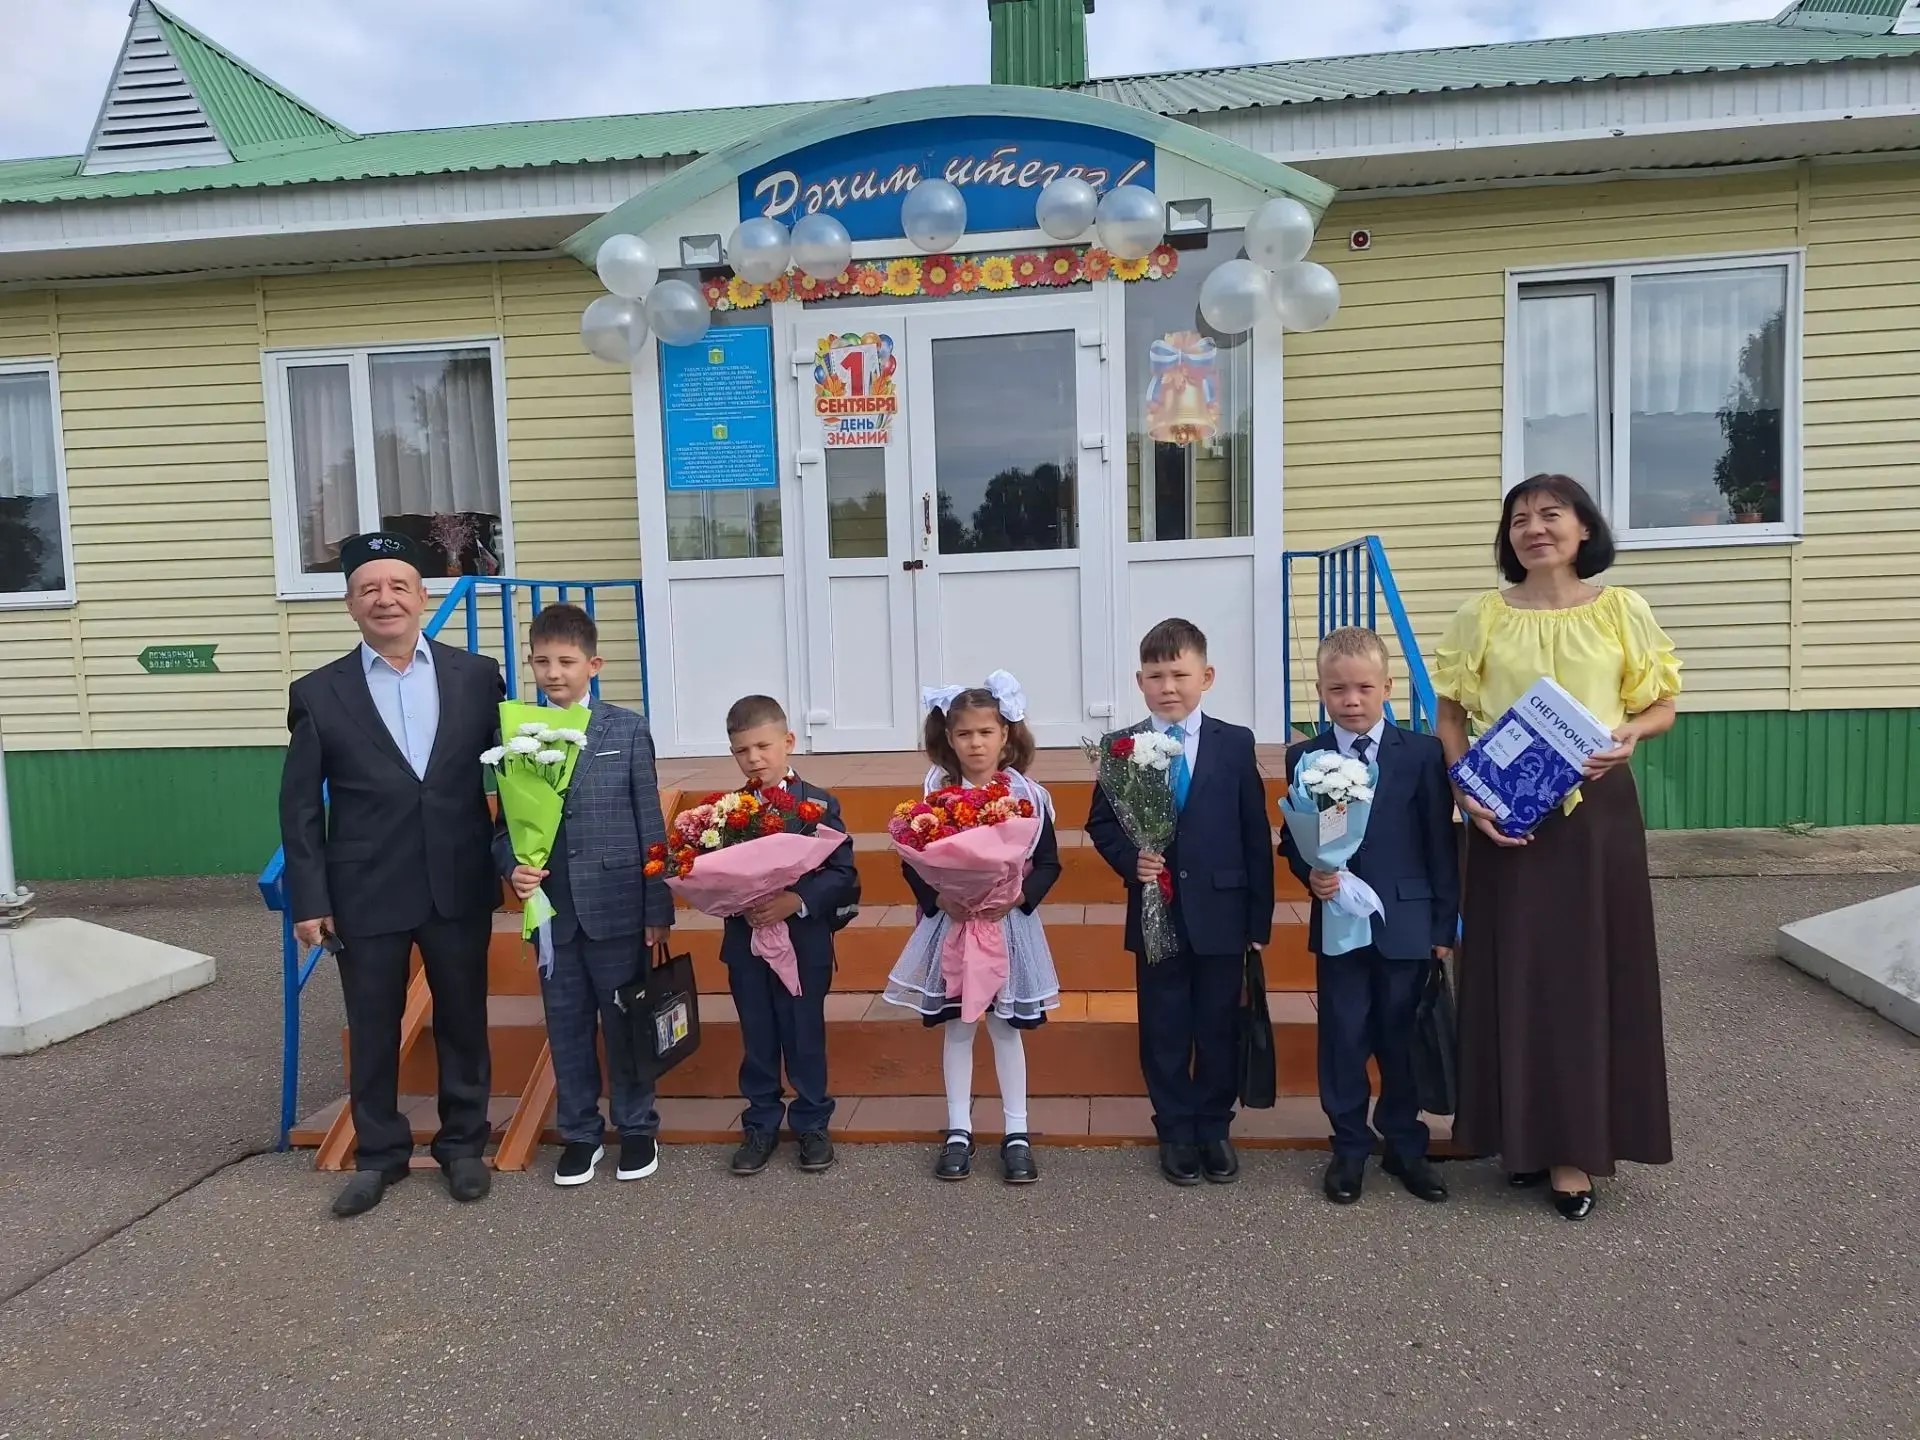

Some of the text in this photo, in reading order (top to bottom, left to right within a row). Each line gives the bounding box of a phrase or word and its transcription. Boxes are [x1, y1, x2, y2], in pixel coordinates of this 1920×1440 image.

[840, 351, 865, 396] 1
[817, 396, 896, 414] СЕНТЯБРЯ
[840, 418, 875, 432] ДЕНЬ
[827, 430, 888, 446] ЗНАНИЙ
[1529, 695, 1595, 757] СНЕГУРОЧКА
